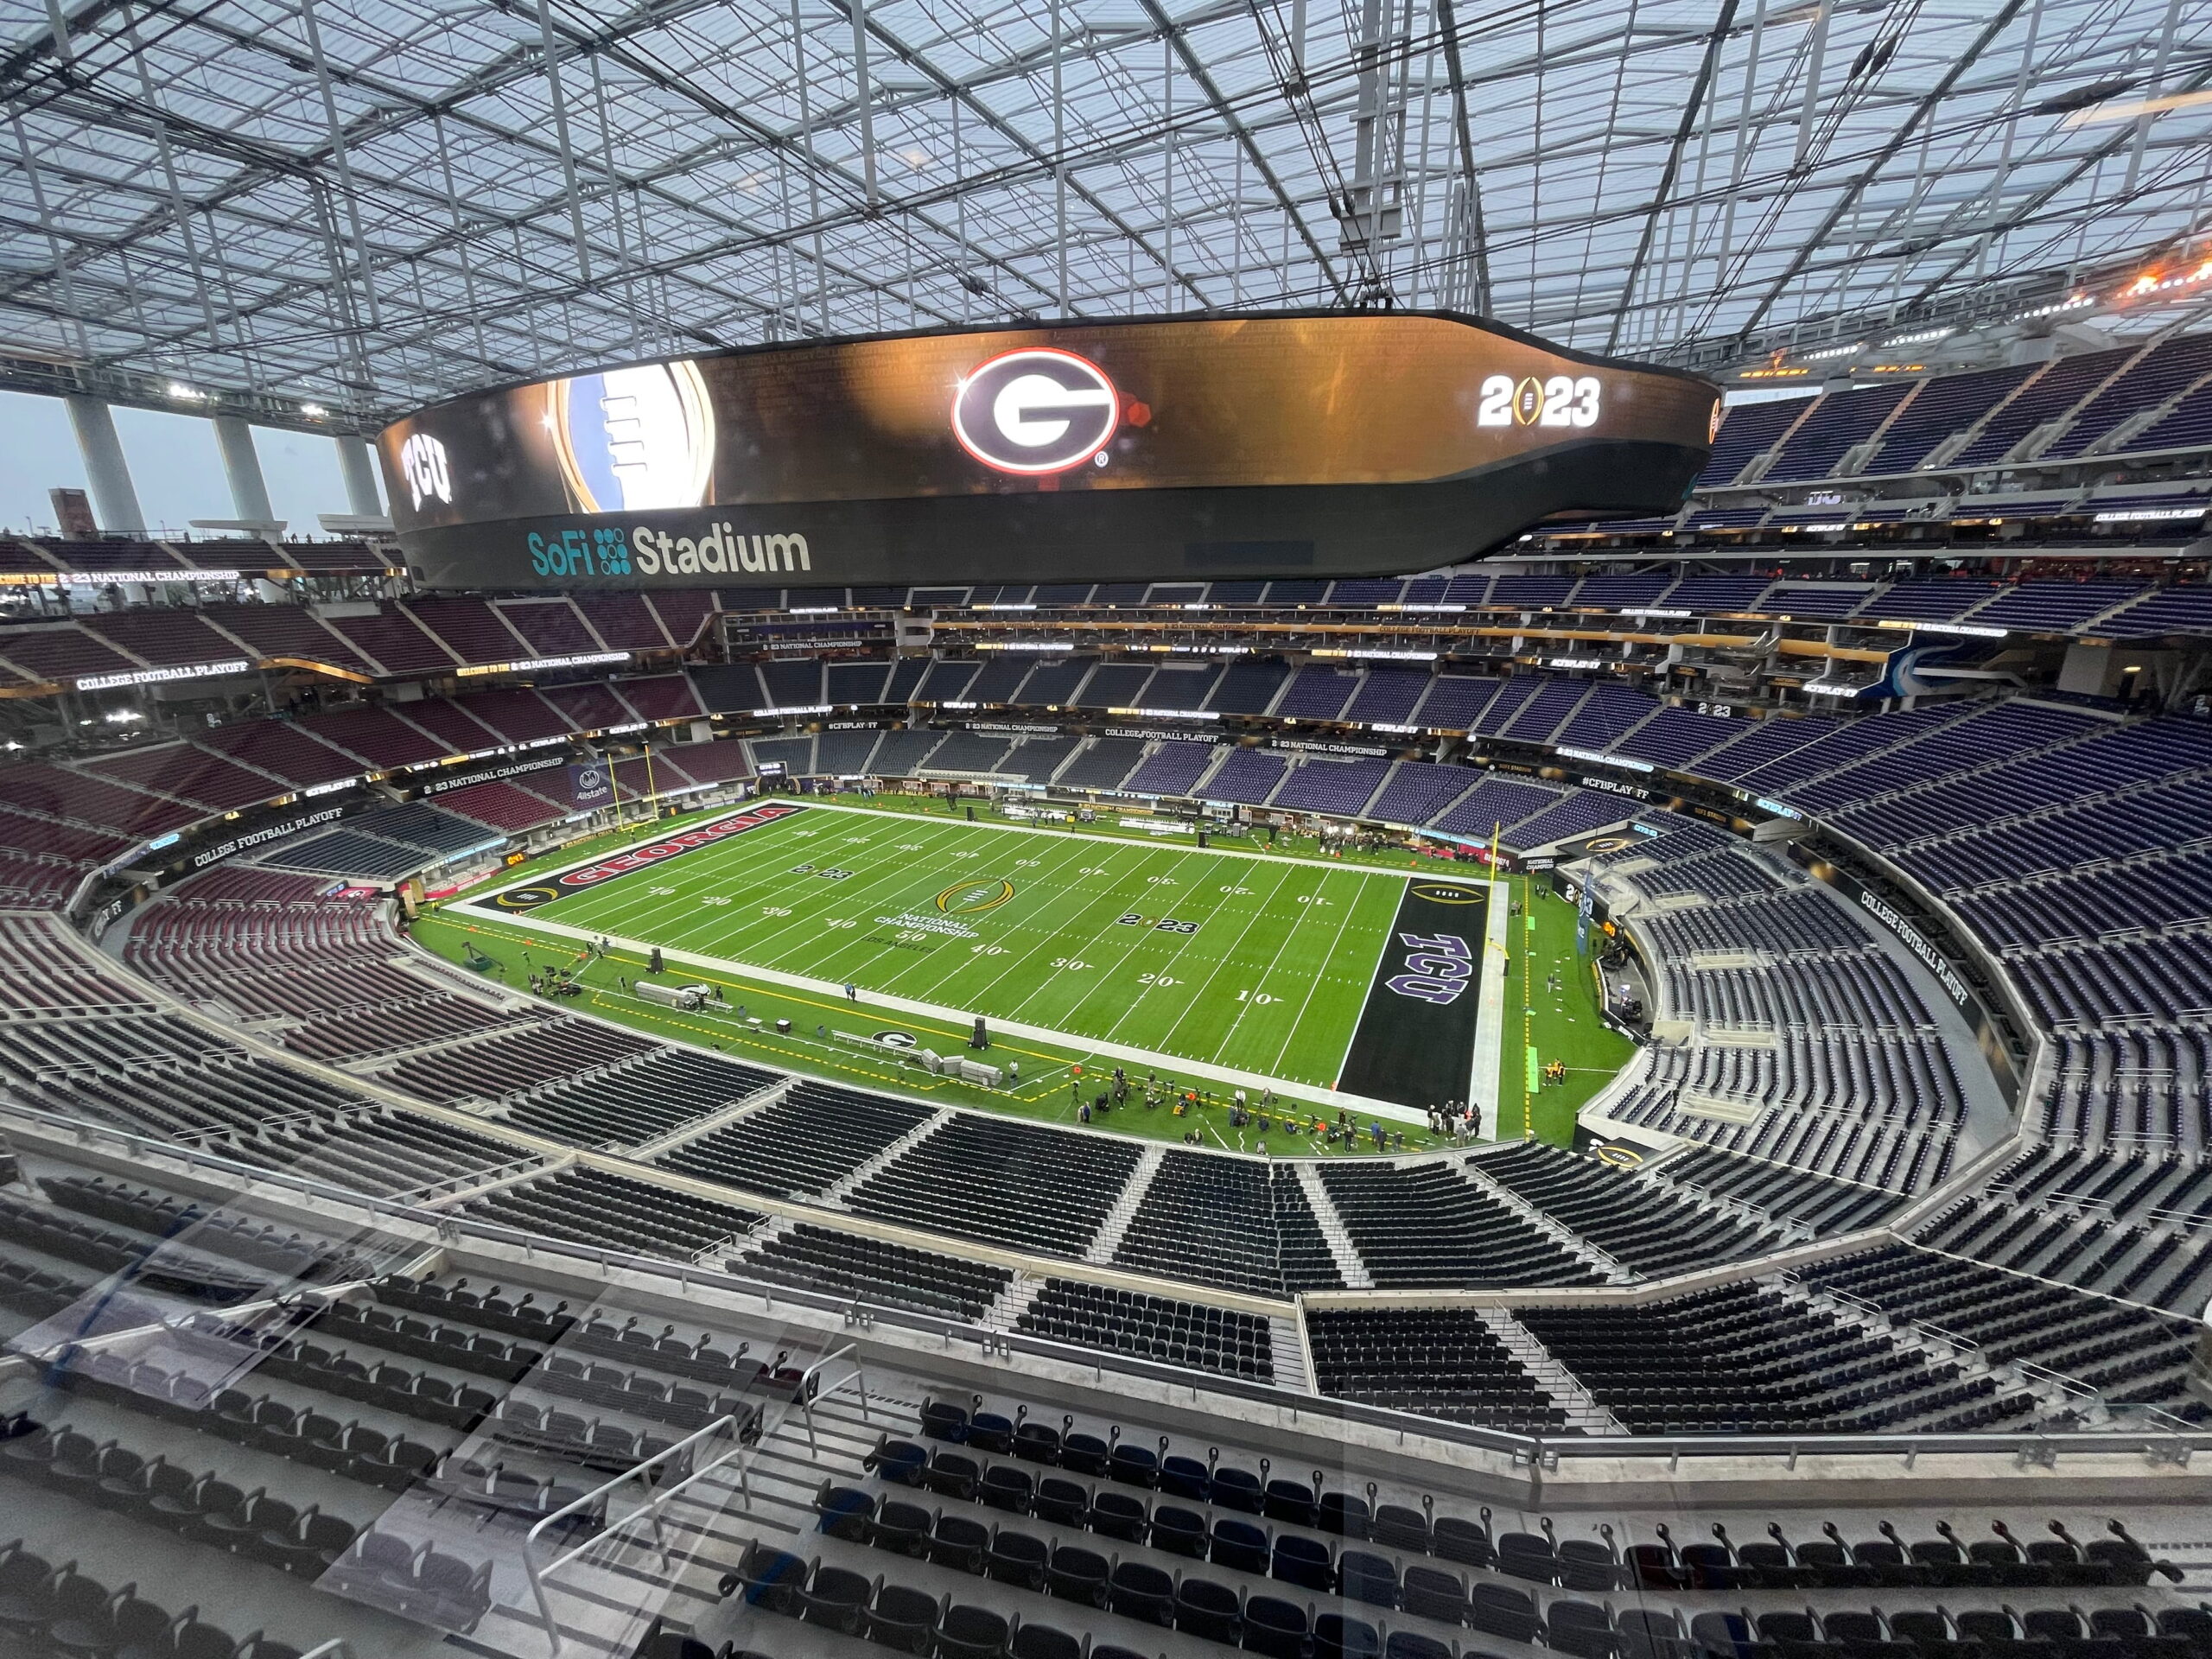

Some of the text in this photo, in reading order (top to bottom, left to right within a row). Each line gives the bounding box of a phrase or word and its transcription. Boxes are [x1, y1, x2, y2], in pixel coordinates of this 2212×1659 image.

[401, 434, 450, 512] TCU
[528, 522, 811, 576] SoFi Stadium
[59, 573, 91, 583] 223
[91, 572, 156, 583] NATIONAL
[158, 571, 240, 582] CHAMPIONSHIP
[532, 658, 572, 669] NATIONAL
[572, 652, 631, 664] CHAMPIONSHIP
[77, 662, 249, 691] COLLEGE FOOTBALL PLAYOFF
[1012, 724, 1058, 733] CHAMPIONSHIP
[1141, 730, 1182, 741] FOOTBALL
[1183, 734, 1218, 743] PLAYOFF
[1272, 740, 1387, 756] 223 NATIONAL CHAMPIONSHIP
[1573, 751, 1605, 762] NATIONAL
[424, 757, 563, 794] 223 NATIONAL CHAMPIONSHIP
[576, 785, 607, 801] Allstate
[194, 842, 237, 868] COLLEGE
[238, 823, 296, 849] FOOTBALL
[296, 807, 343, 830] PLAYOFF
[559, 805, 799, 886] GEORGIA
[1015, 859, 1040, 868] 50
[1078, 867, 1104, 876] 40
[1147, 876, 1174, 886] 30
[1220, 885, 1249, 894] 20
[704, 896, 732, 906] 20
[1297, 895, 1326, 906] 10
[763, 906, 792, 918] 30
[827, 918, 856, 929] 40
[874, 916, 979, 939] CHAMPIONSHIP
[898, 913, 969, 931] NATIONAL
[894, 931, 926, 942] 50
[884, 938, 937, 954] ANGELES
[970, 944, 1004, 956] 40
[1861, 892, 1967, 1006] COLLEGE FOOTBALL PLAYOFF
[1050, 957, 1084, 970] 30
[1385, 933, 1472, 1005] TCU
[1136, 973, 1174, 987] 20
[1235, 989, 1271, 1005] 10
